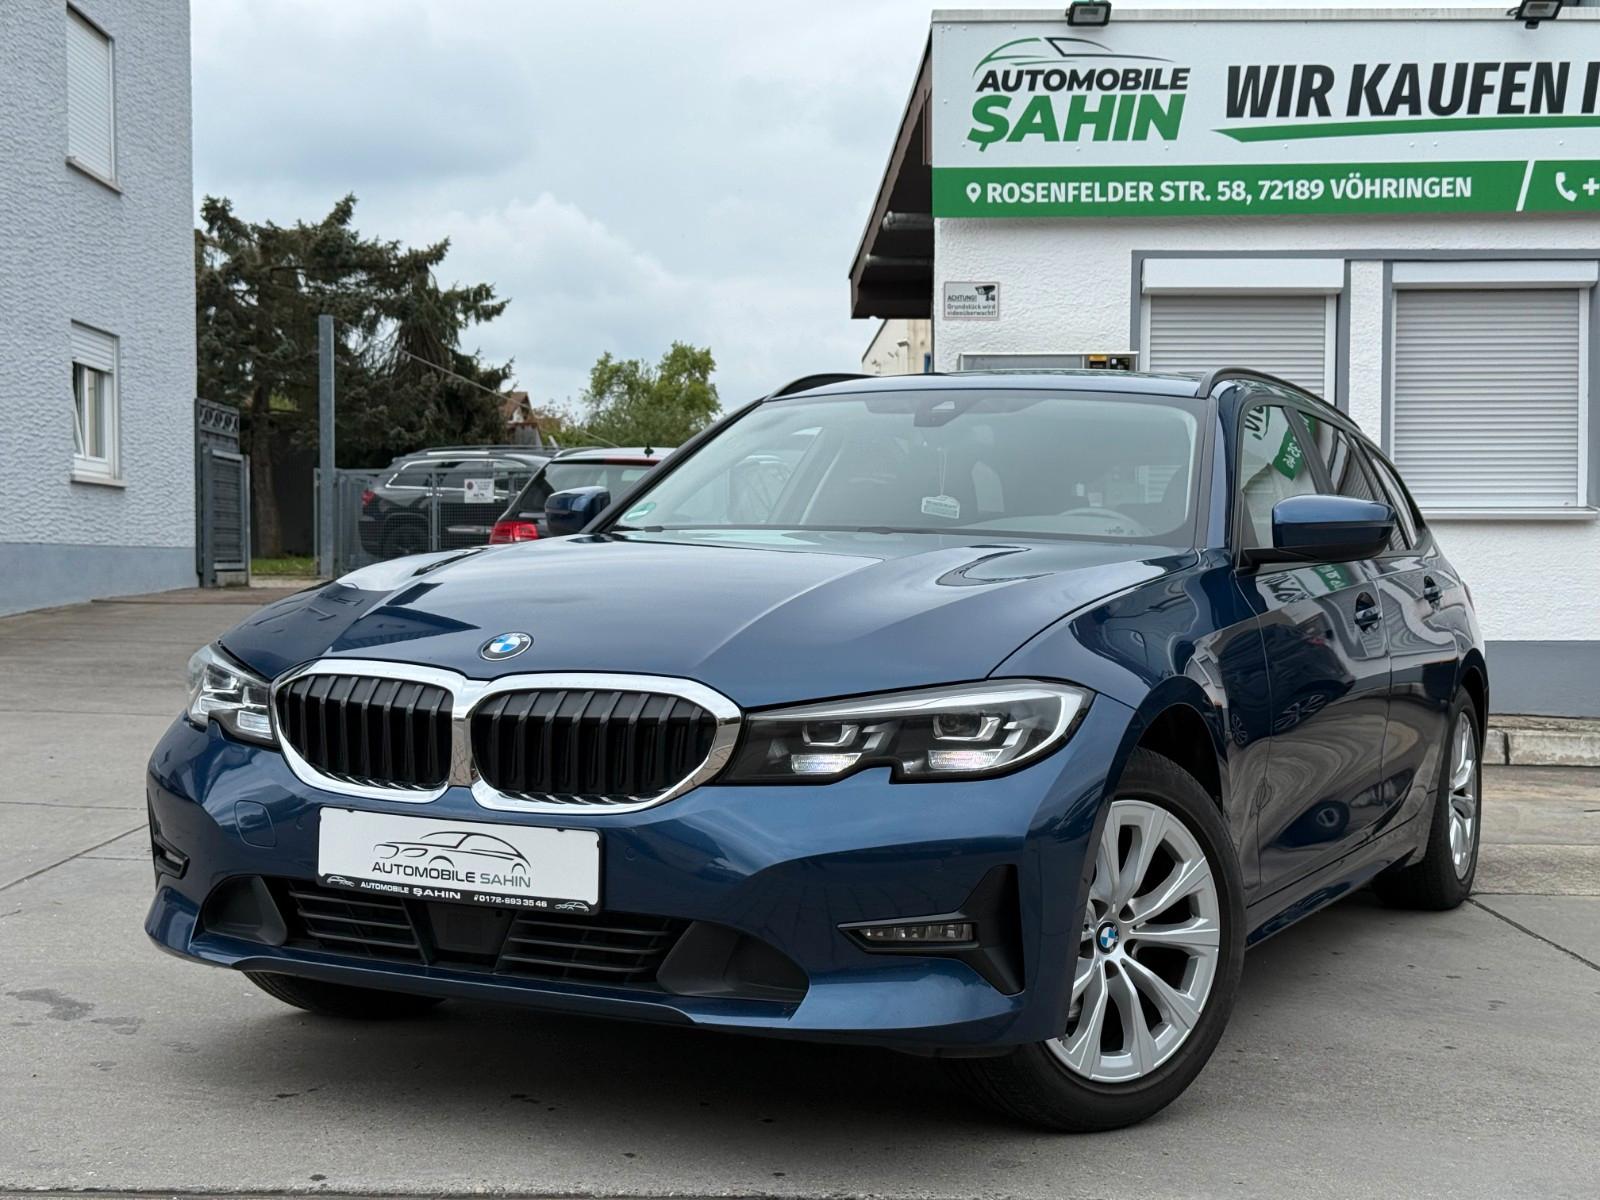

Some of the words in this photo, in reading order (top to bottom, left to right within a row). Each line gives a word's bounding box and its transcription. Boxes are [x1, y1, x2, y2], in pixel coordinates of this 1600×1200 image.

[976, 68, 1190, 92] AUTOMOBILE
[1226, 64, 1335, 118] WIR
[1346, 62, 1571, 116] KAUFEN
[967, 93, 1186, 152] ŞAHIN
[987, 182, 1154, 203] ROSENFELDER
[1160, 181, 1211, 202] STR.
[1217, 180, 1252, 206] 58,
[1258, 179, 1325, 200] 72189
[1330, 172, 1473, 200] VÖHRINGEN
[360, 881, 410, 894] AUTOMOBILE
[413, 887, 461, 899] ŞAHIN
[371, 861, 476, 884] AUTOMOBILE
[480, 873, 531, 889] SAHIN
